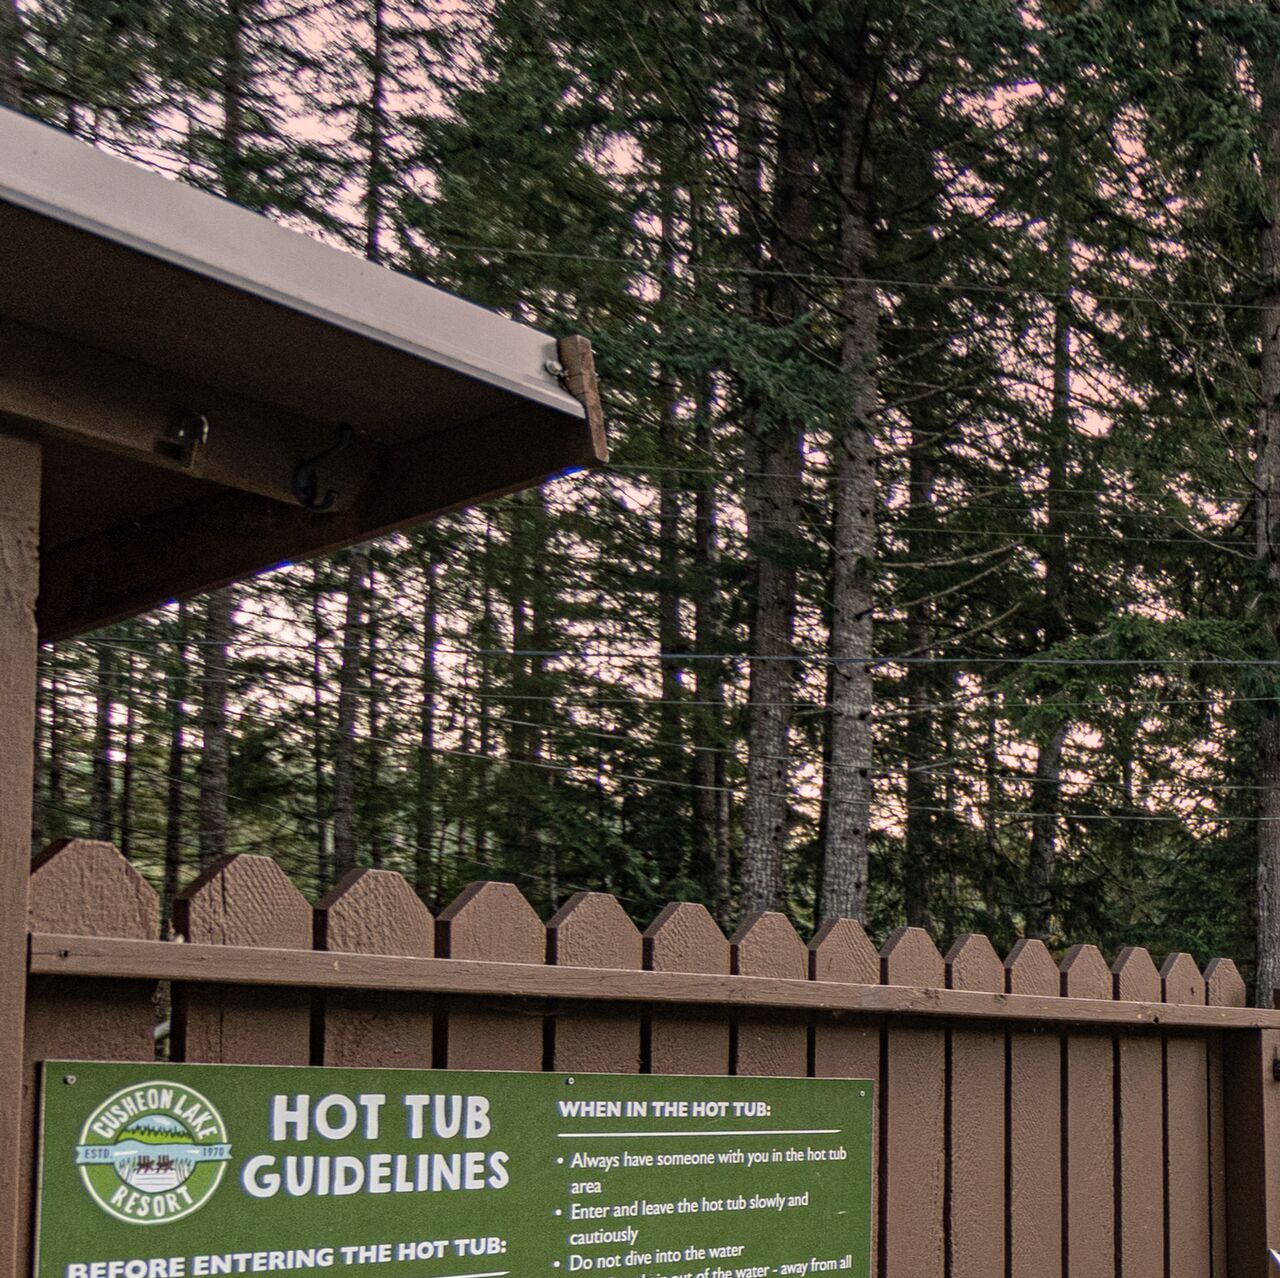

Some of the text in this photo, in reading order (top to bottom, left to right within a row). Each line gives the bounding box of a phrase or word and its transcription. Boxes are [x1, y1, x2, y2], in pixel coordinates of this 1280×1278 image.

[92, 1088, 218, 1140] CUSHEON LAKE
[272, 1093, 491, 1141] HOT TUB
[558, 1100, 771, 1117] WHEN IN THE HOT TUB:
[84, 1147, 224, 1160] ESTD. 1970
[570, 1146, 847, 1172] Always have someone with you in the hot tub
[242, 1150, 509, 1198] GUIDELINES
[570, 1181, 602, 1194] area
[111, 1185, 193, 1217] RESORT
[570, 1191, 809, 1220] Enter and leave the hot tub slowly and
[569, 1225, 639, 1246] cautiously
[192, 1247, 334, 1276] ENTERING
[339, 1243, 392, 1265] THE
[397, 1240, 449, 1261] HOT
[453, 1236, 507, 1257] TUB:
[569, 1245, 745, 1271] Do not dive into the water
